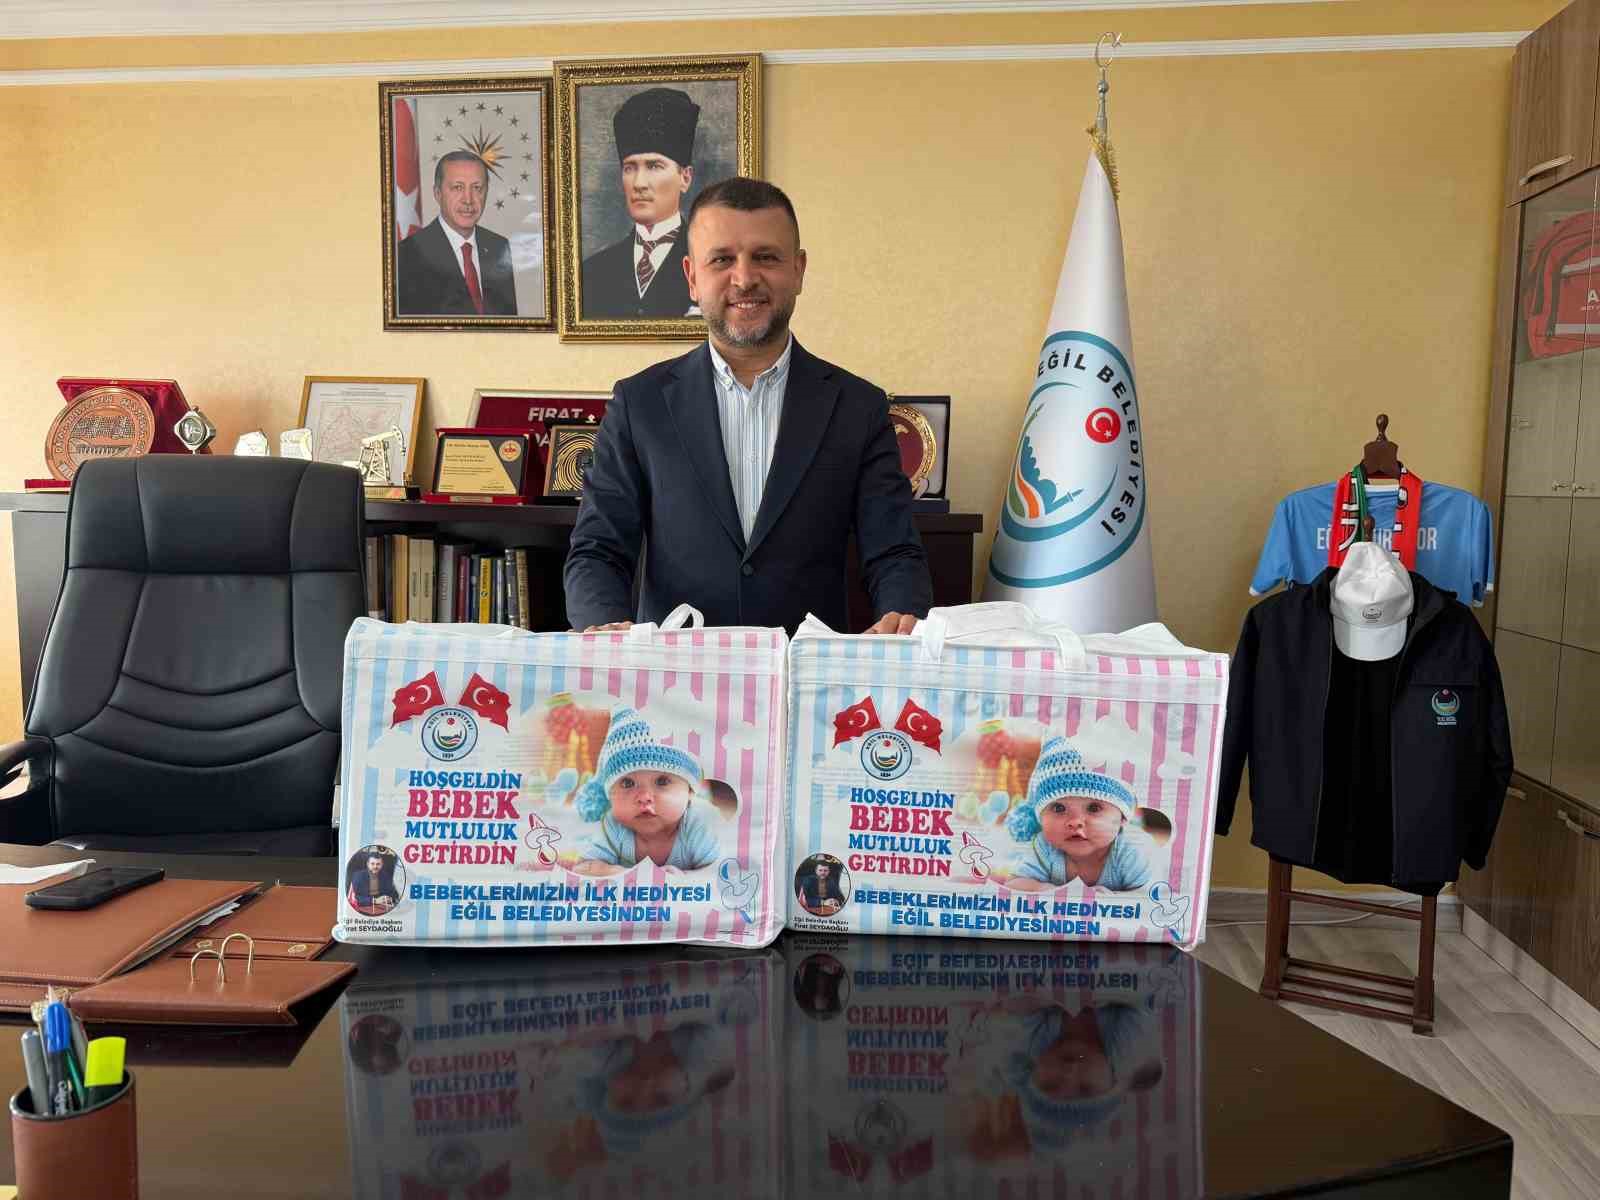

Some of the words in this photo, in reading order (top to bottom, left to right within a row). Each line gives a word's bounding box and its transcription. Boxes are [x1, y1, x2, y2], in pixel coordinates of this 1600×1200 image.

[528, 407, 583, 421] FIRAT
[1037, 349, 1086, 377] EĞİL
[1096, 365, 1140, 537] BELEDİYESİ
[409, 769, 522, 789] HOŞGELDİN
[407, 789, 520, 819] BEBEK
[849, 787, 955, 808] HOŞGELDİN
[404, 821, 517, 840] MUTLULUK
[849, 805, 954, 836] BEBEK
[403, 841, 517, 864] GETİRDİN
[848, 833, 952, 855] MUTLULUK
[848, 852, 952, 876] GETİRDİN
[410, 882, 579, 901] BEBEKLERİMİZİN
[585, 883, 617, 901] İLK
[623, 883, 711, 901] HEDİYESİ
[451, 902, 497, 921] EĞİL
[503, 902, 671, 922] BELEDİYESİNDEN
[854, 889, 1011, 912] BEBEKLERİMİZİN
[1016, 896, 1048, 914] İLK
[1053, 900, 1140, 919] HEDİYESİ
[892, 908, 934, 926] EĞİL
[939, 912, 1100, 935] BELEDİYESİNDEN
